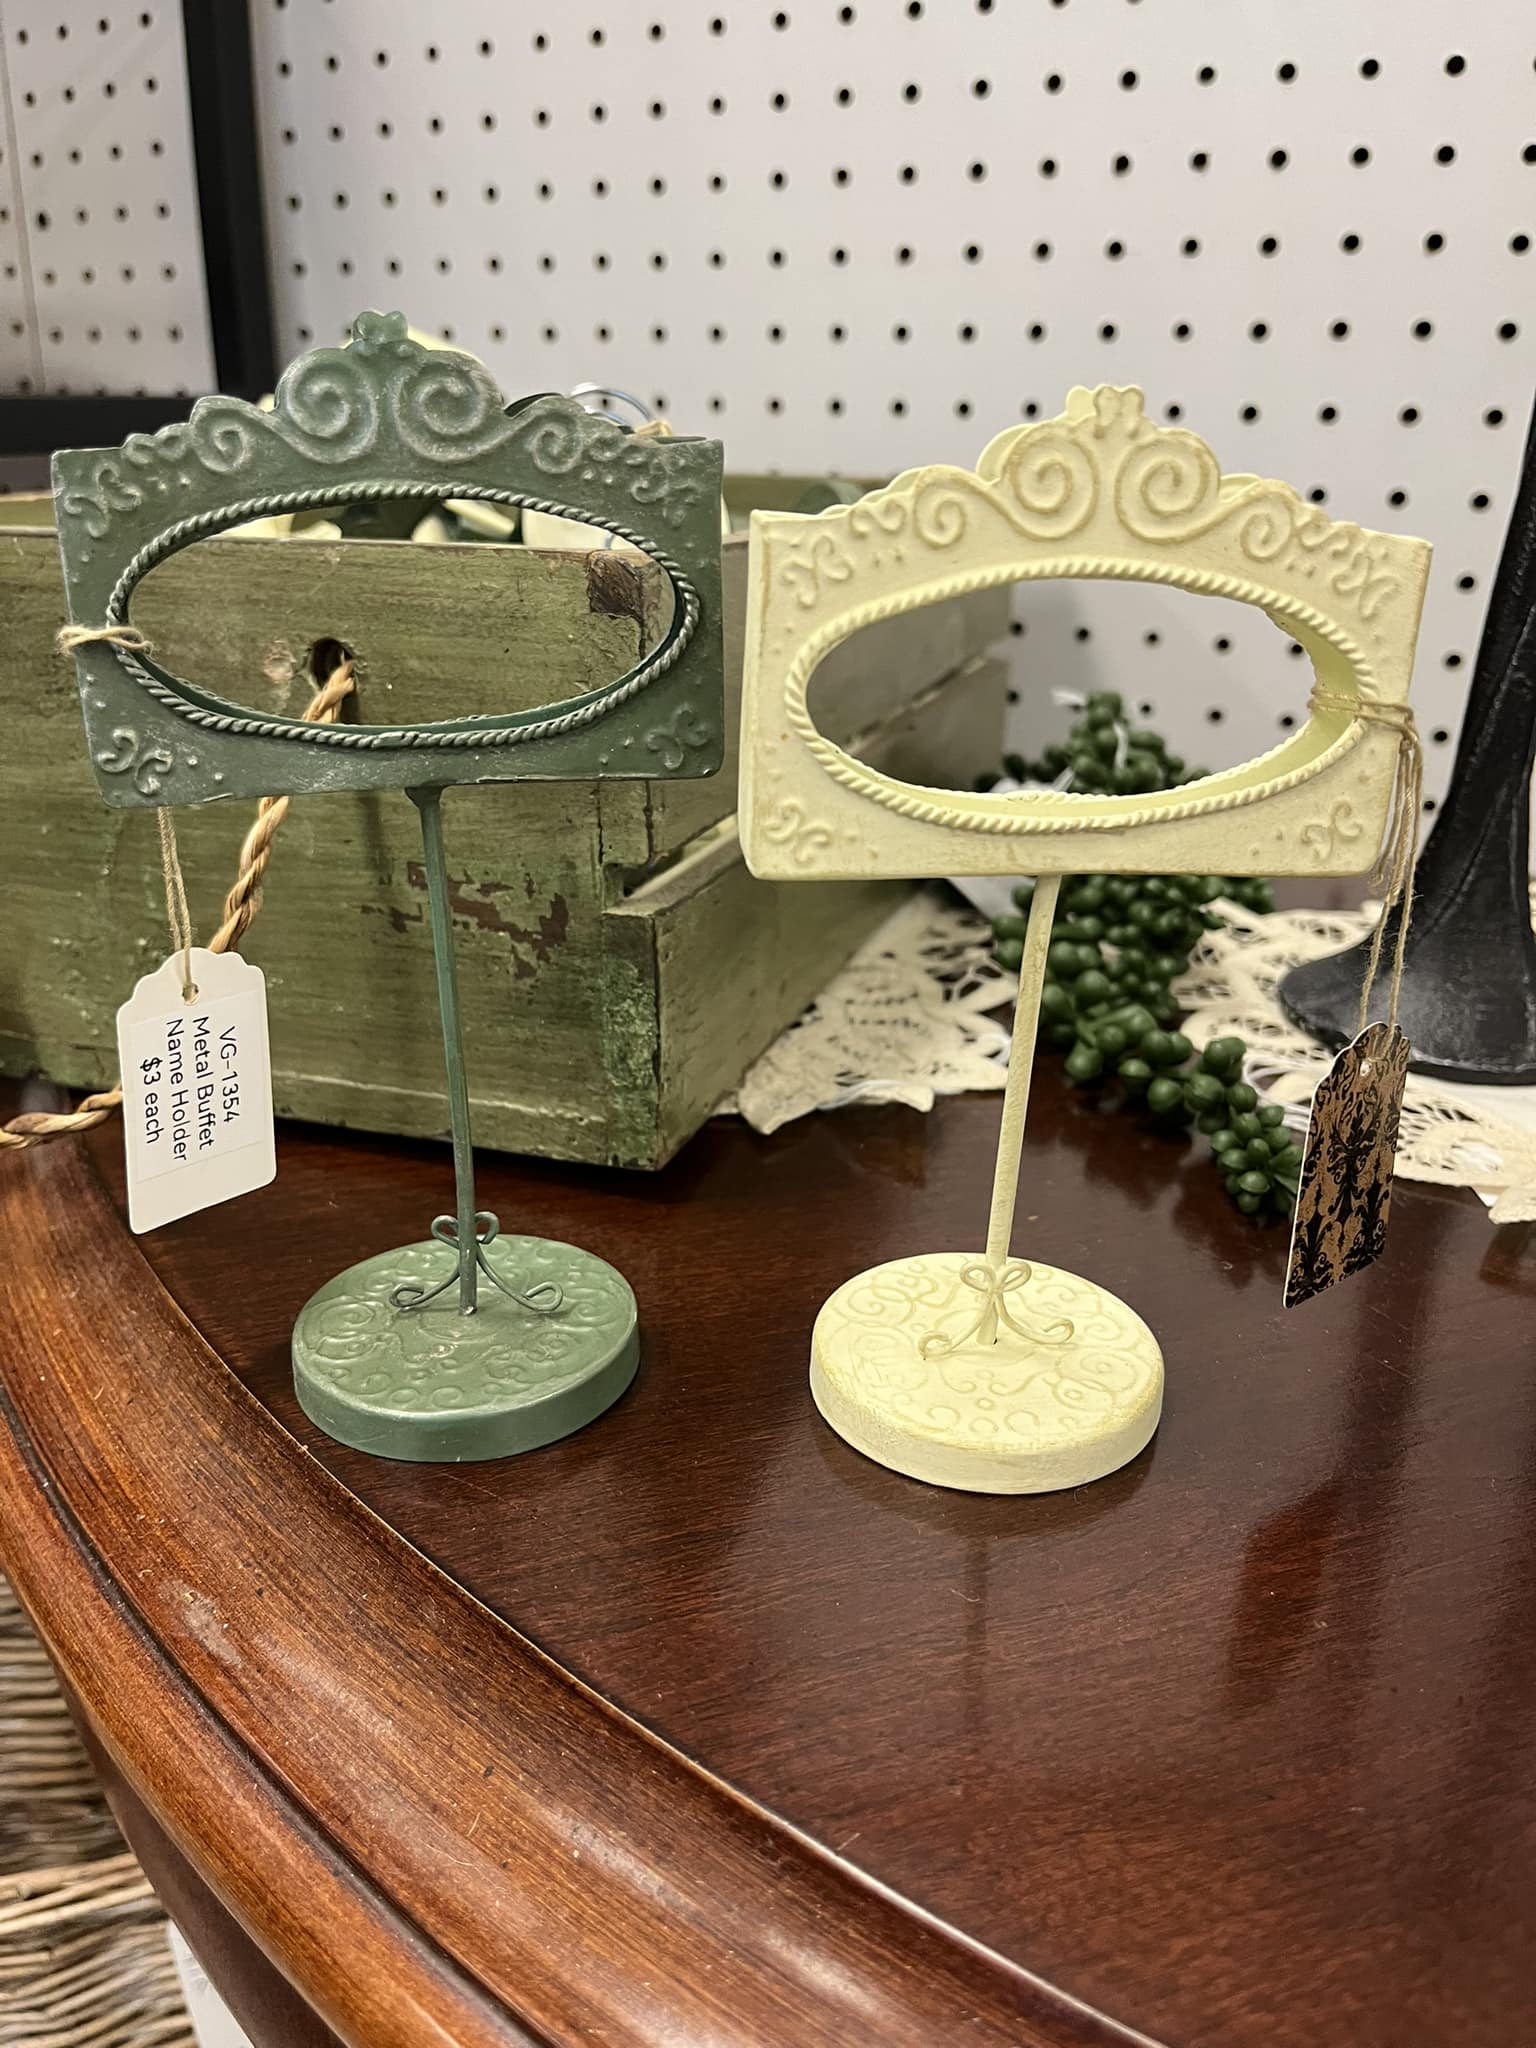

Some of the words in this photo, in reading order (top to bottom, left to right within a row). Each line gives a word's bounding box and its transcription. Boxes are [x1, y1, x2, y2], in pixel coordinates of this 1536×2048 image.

[139, 1057, 163, 1086] $3
[166, 1018, 185, 1085] Name
[193, 1016, 214, 1079] Metal
[218, 1026, 240, 1123] VG-1354
[144, 1092, 164, 1144] each
[171, 1089, 191, 1161] Holder
[197, 1083, 216, 1151] Buffet
